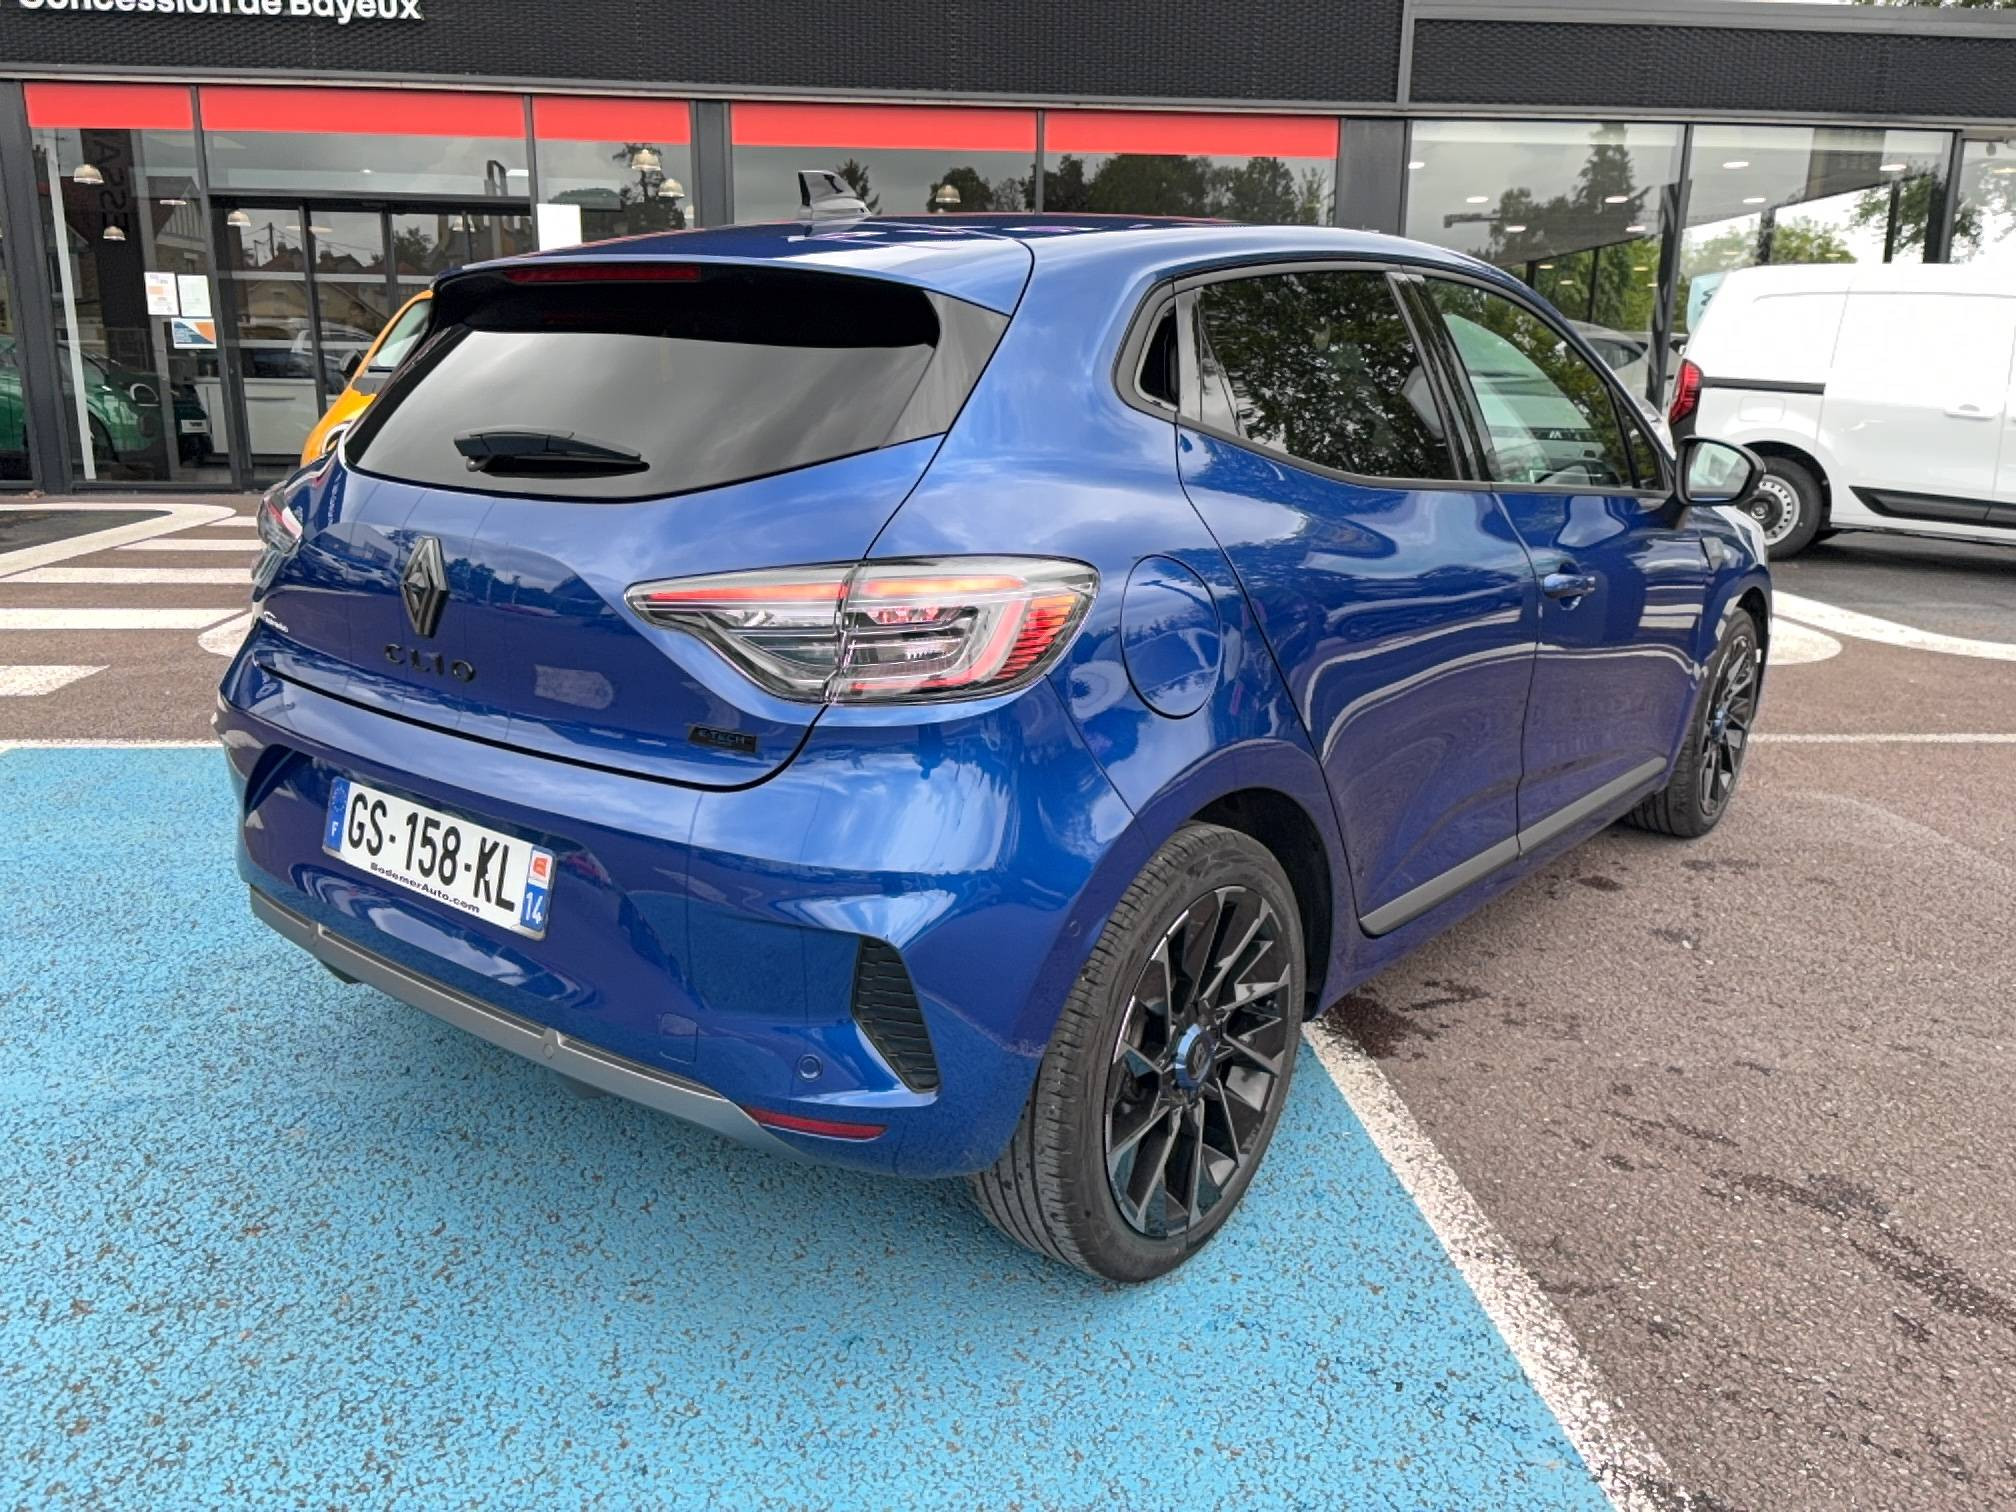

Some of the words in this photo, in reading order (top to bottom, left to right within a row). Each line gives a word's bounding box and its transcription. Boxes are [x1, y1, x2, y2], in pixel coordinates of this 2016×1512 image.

[238, 0, 282, 15] de
[290, 0, 422, 24] Bayeux
[384, 643, 476, 682] CLIO
[331, 821, 339, 837] F
[347, 792, 515, 912] GS-158-KL
[370, 862, 480, 913] BodemerAuto.com
[526, 891, 543, 924] 14
